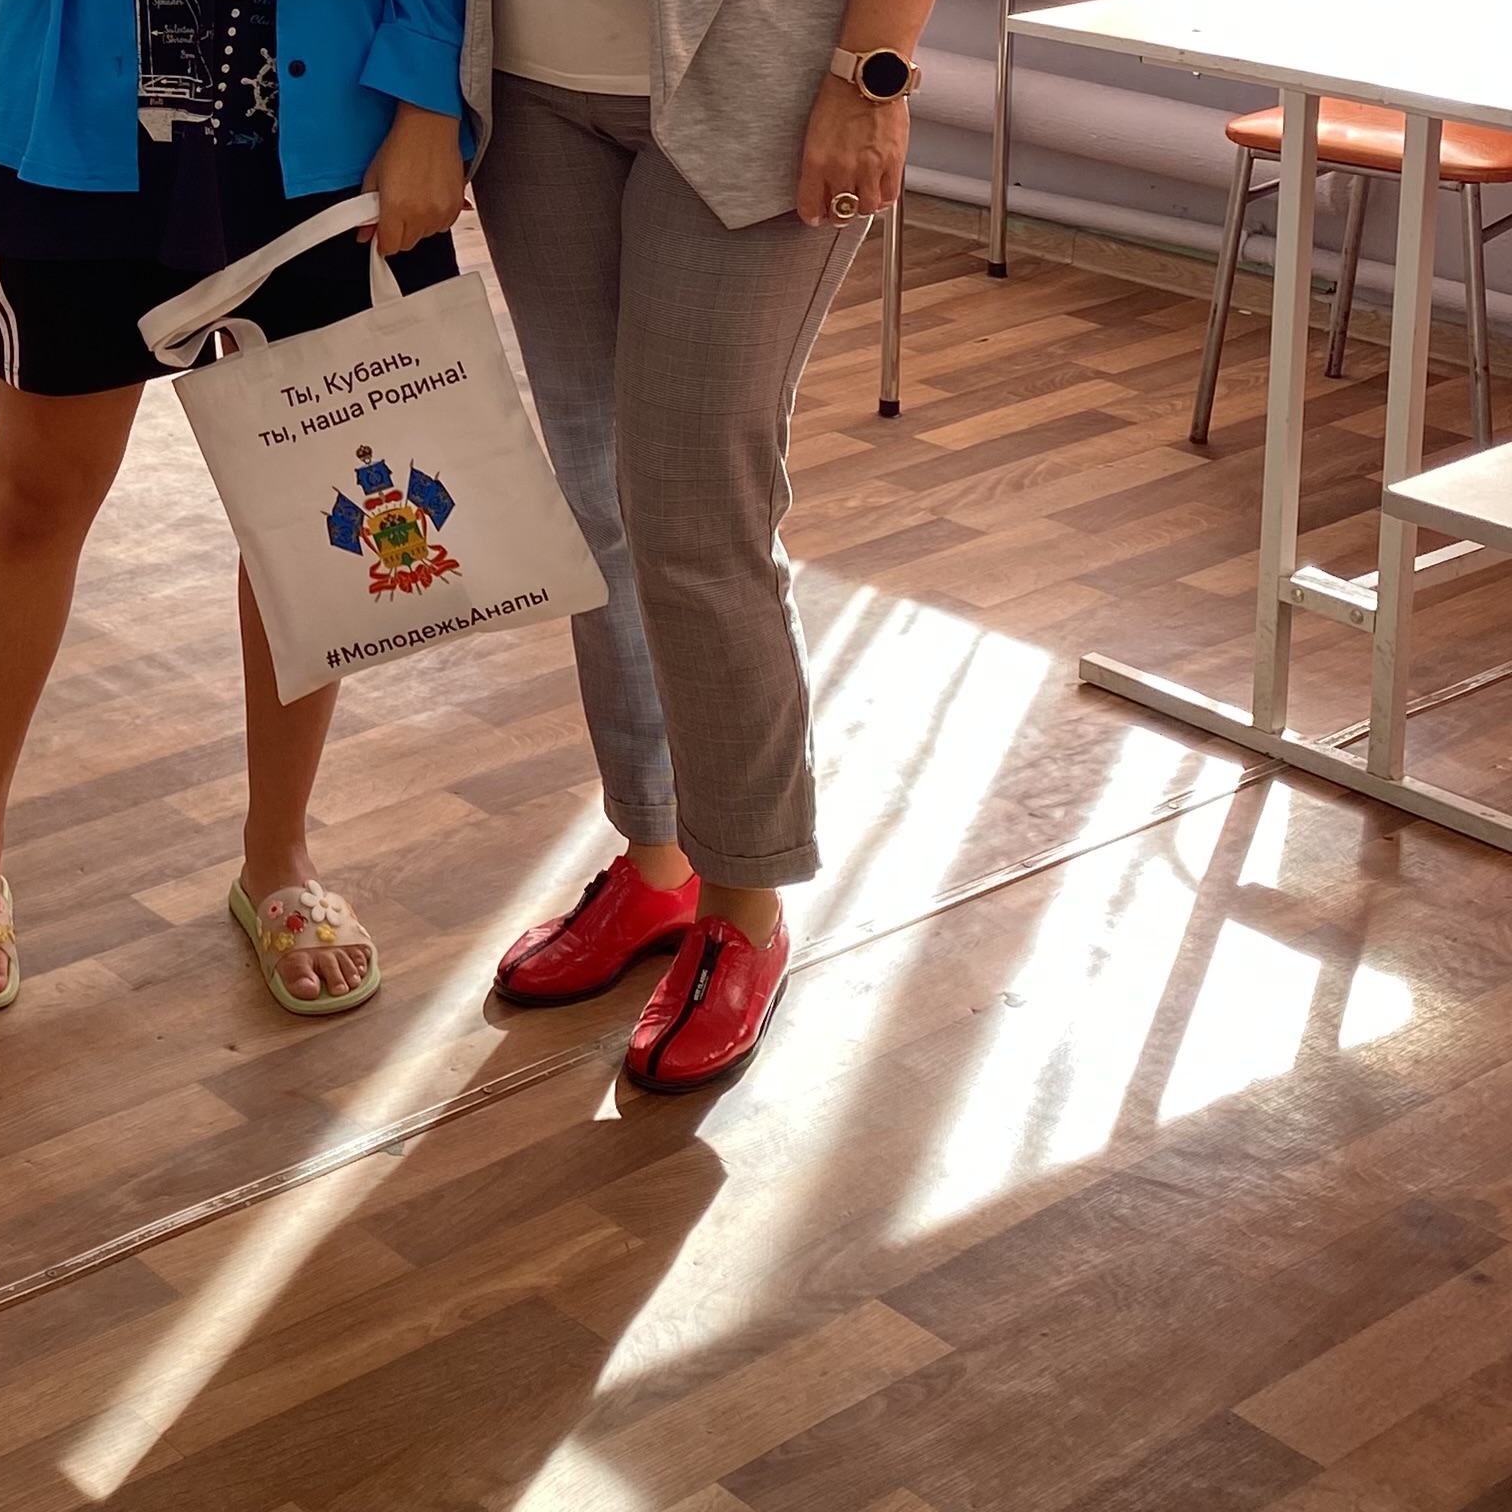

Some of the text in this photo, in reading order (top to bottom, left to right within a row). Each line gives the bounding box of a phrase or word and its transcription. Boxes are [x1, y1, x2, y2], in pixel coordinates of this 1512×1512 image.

[258, 360, 468, 447] ты, наша Родина!
[280, 352, 420, 407] Ты, Кубань,
[326, 587, 550, 669] #МолодежьАнапы
